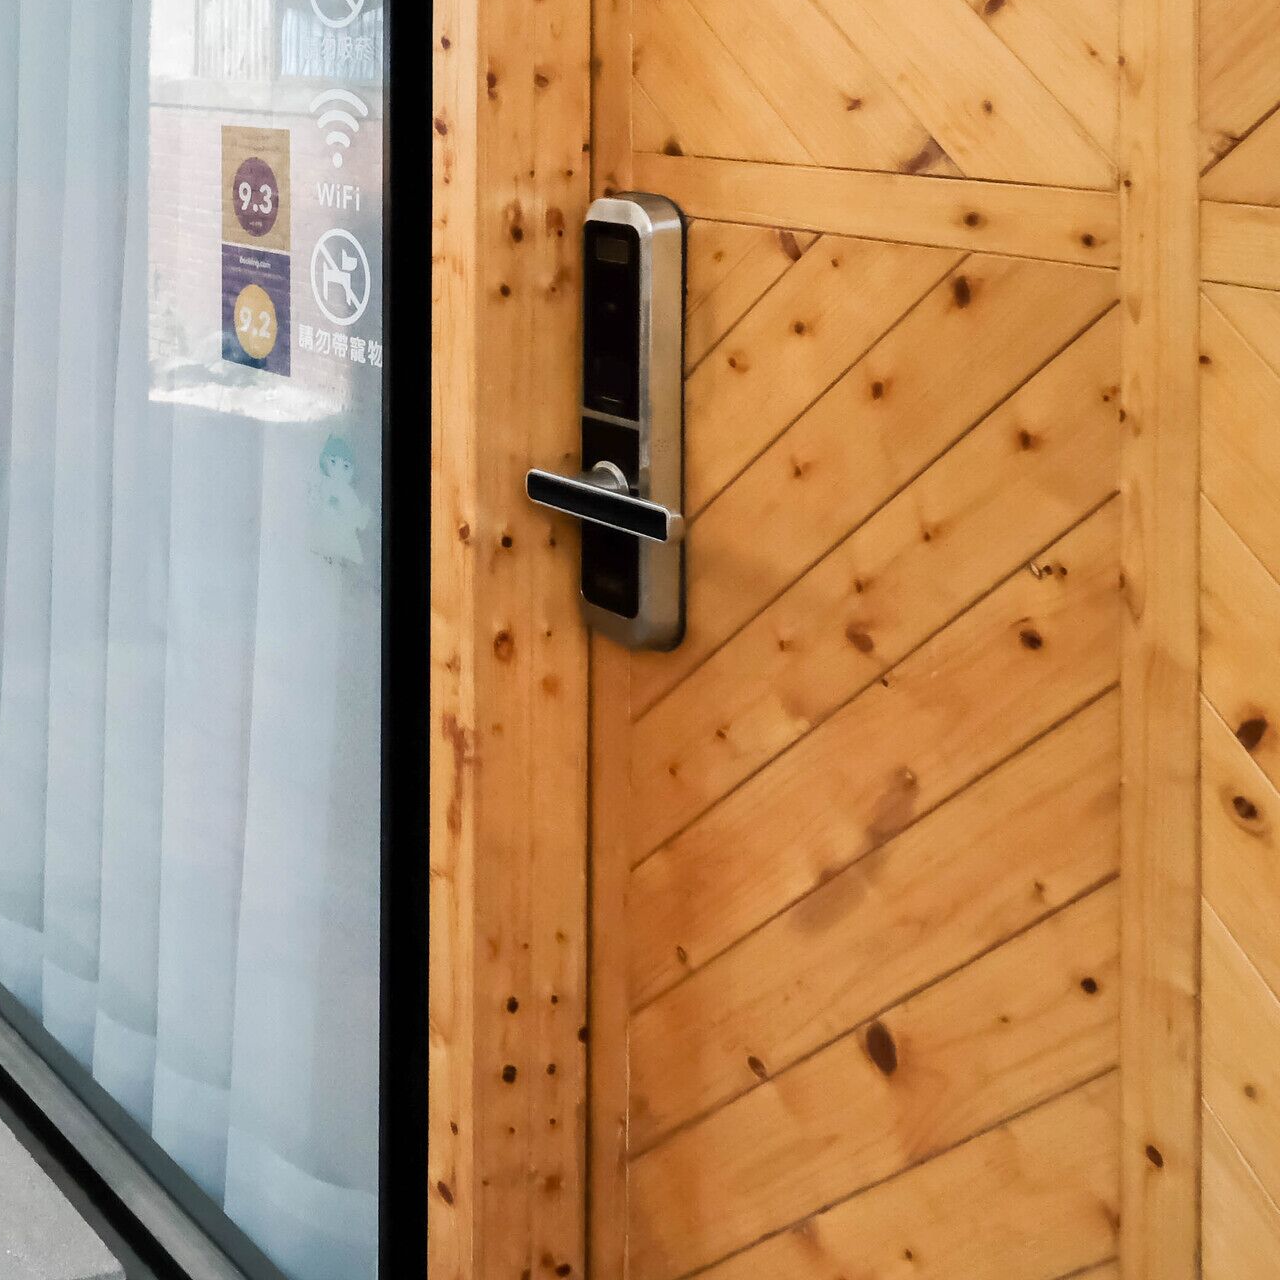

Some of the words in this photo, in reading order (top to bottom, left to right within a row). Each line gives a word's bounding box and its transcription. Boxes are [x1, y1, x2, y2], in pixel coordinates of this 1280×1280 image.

[238, 181, 272, 214] 9.3
[316, 183, 360, 211] WiFi
[239, 305, 271, 338] 9.2
[298, 323, 383, 368] 請勿帶寵物
